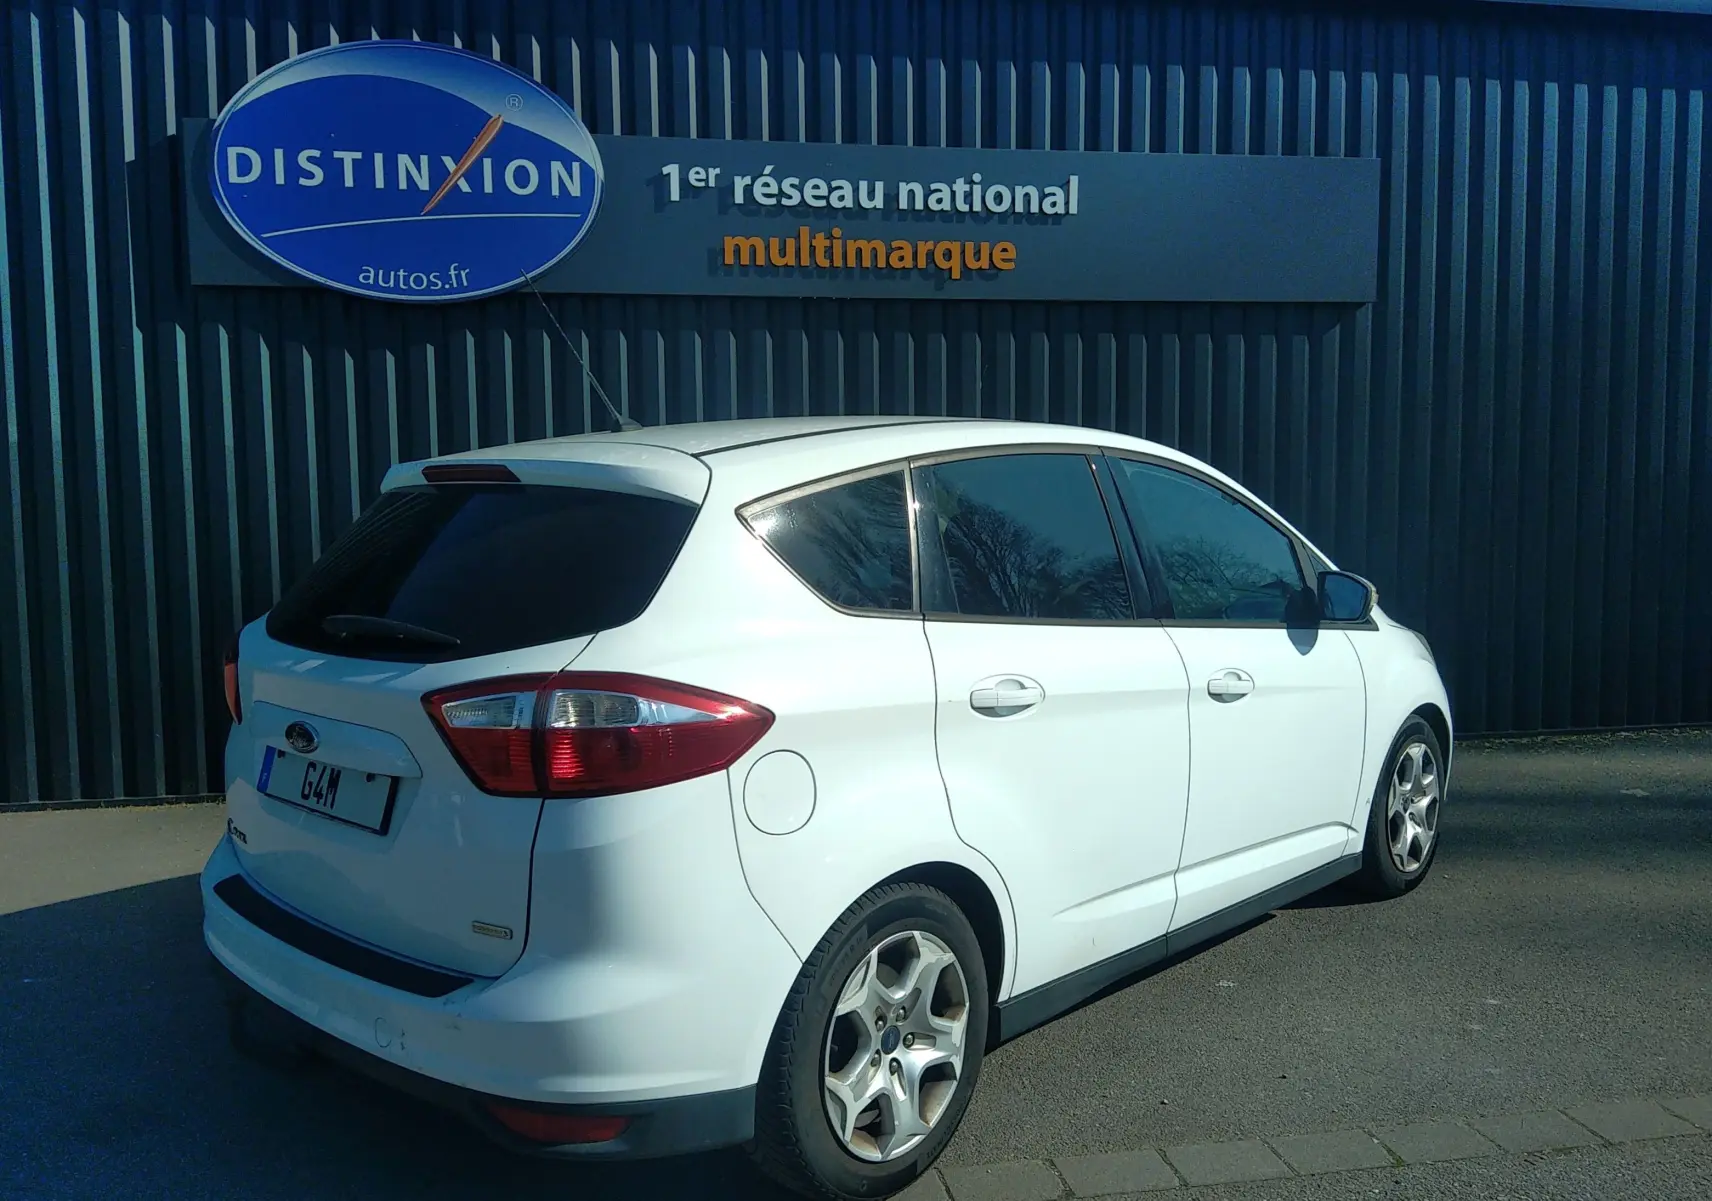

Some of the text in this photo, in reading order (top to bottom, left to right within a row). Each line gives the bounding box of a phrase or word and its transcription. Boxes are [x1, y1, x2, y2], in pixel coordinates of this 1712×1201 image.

[227, 146, 582, 199] DISTINXION
[661, 163, 1079, 215] 1er réseau national
[359, 264, 471, 291] autos.fr
[723, 227, 1018, 279] multimarque
[301, 761, 342, 810] G4M
